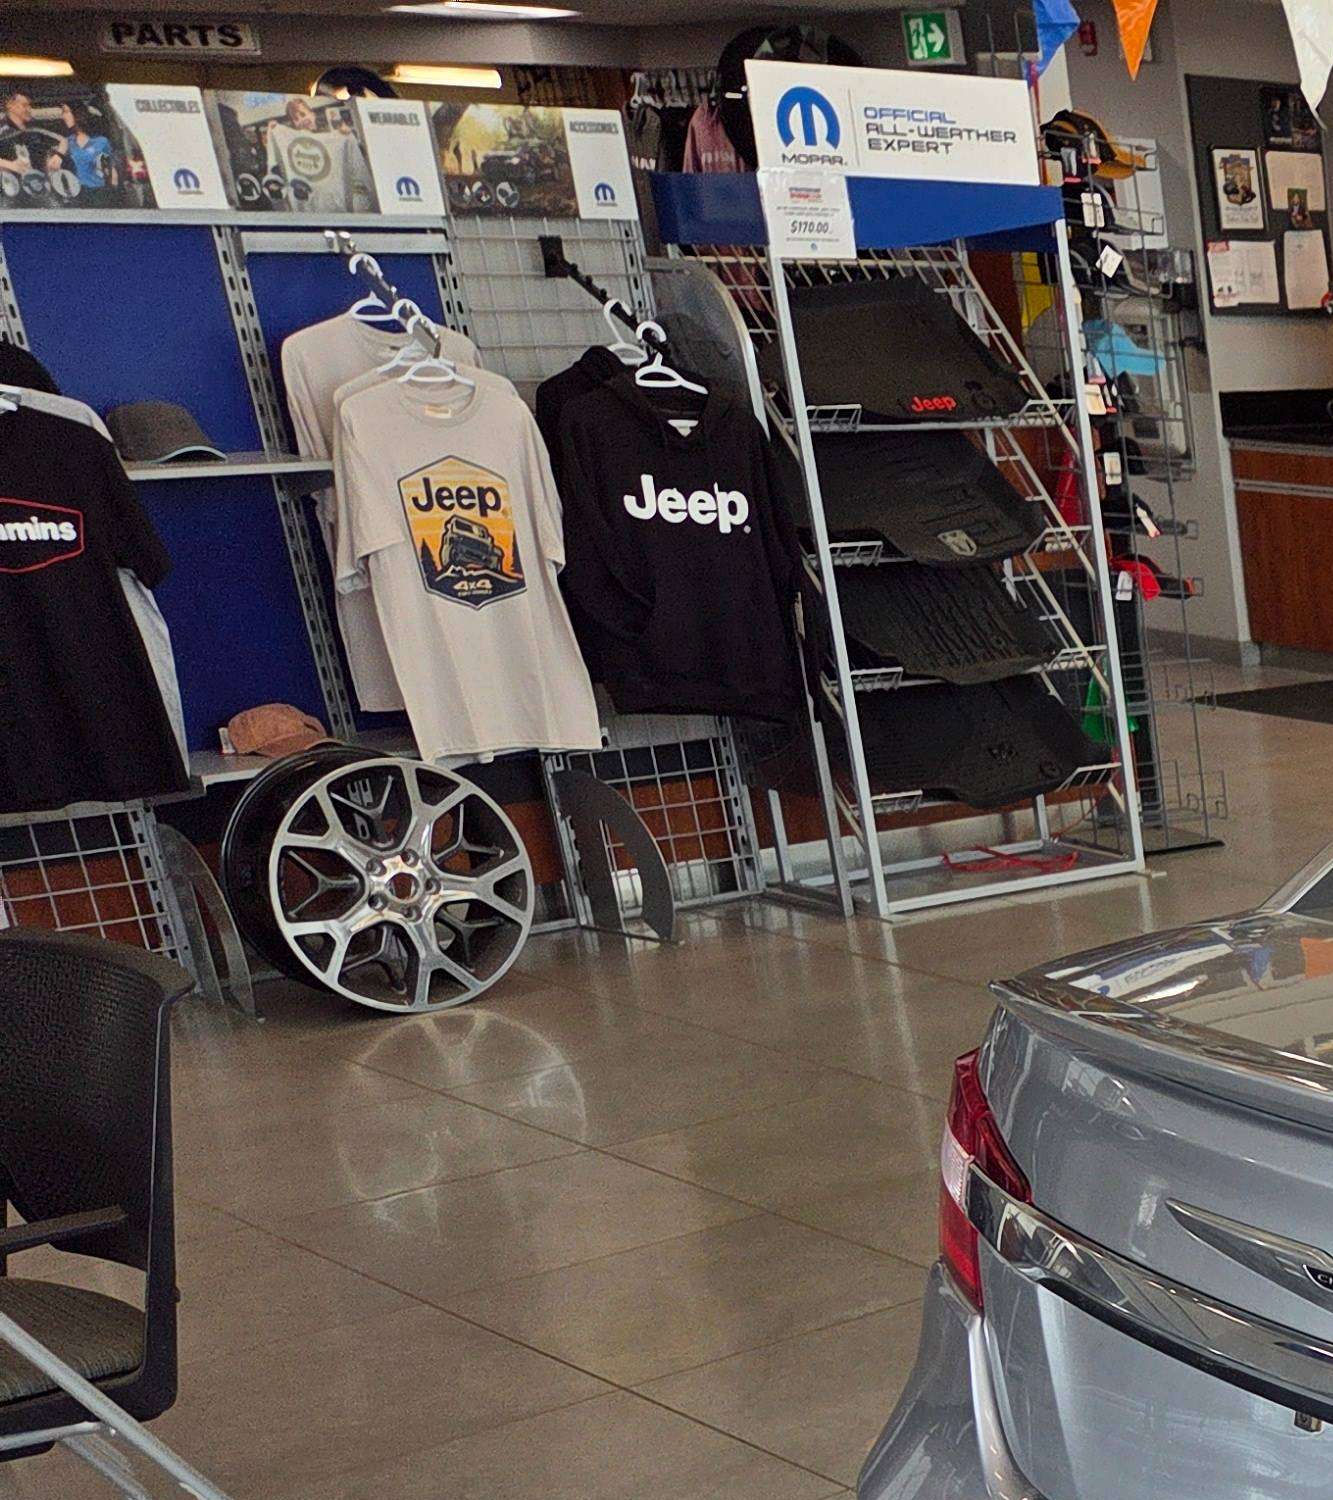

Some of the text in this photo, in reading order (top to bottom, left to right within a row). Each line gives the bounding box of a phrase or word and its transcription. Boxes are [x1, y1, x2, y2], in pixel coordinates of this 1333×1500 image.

[110, 22, 244, 48] PARTS
[367, 111, 421, 127] WEARABLES
[864, 106, 956, 124] OFFICIAL
[865, 123, 1017, 143] ALL-WEATHER
[867, 137, 955, 155] EXPERT
[790, 219, 830, 234] $170.00
[911, 395, 958, 412] Jeep
[411, 476, 502, 518] Jeep
[622, 473, 750, 534] Jeep
[0, 515, 78, 542] mins
[452, 578, 494, 592] 4x4
